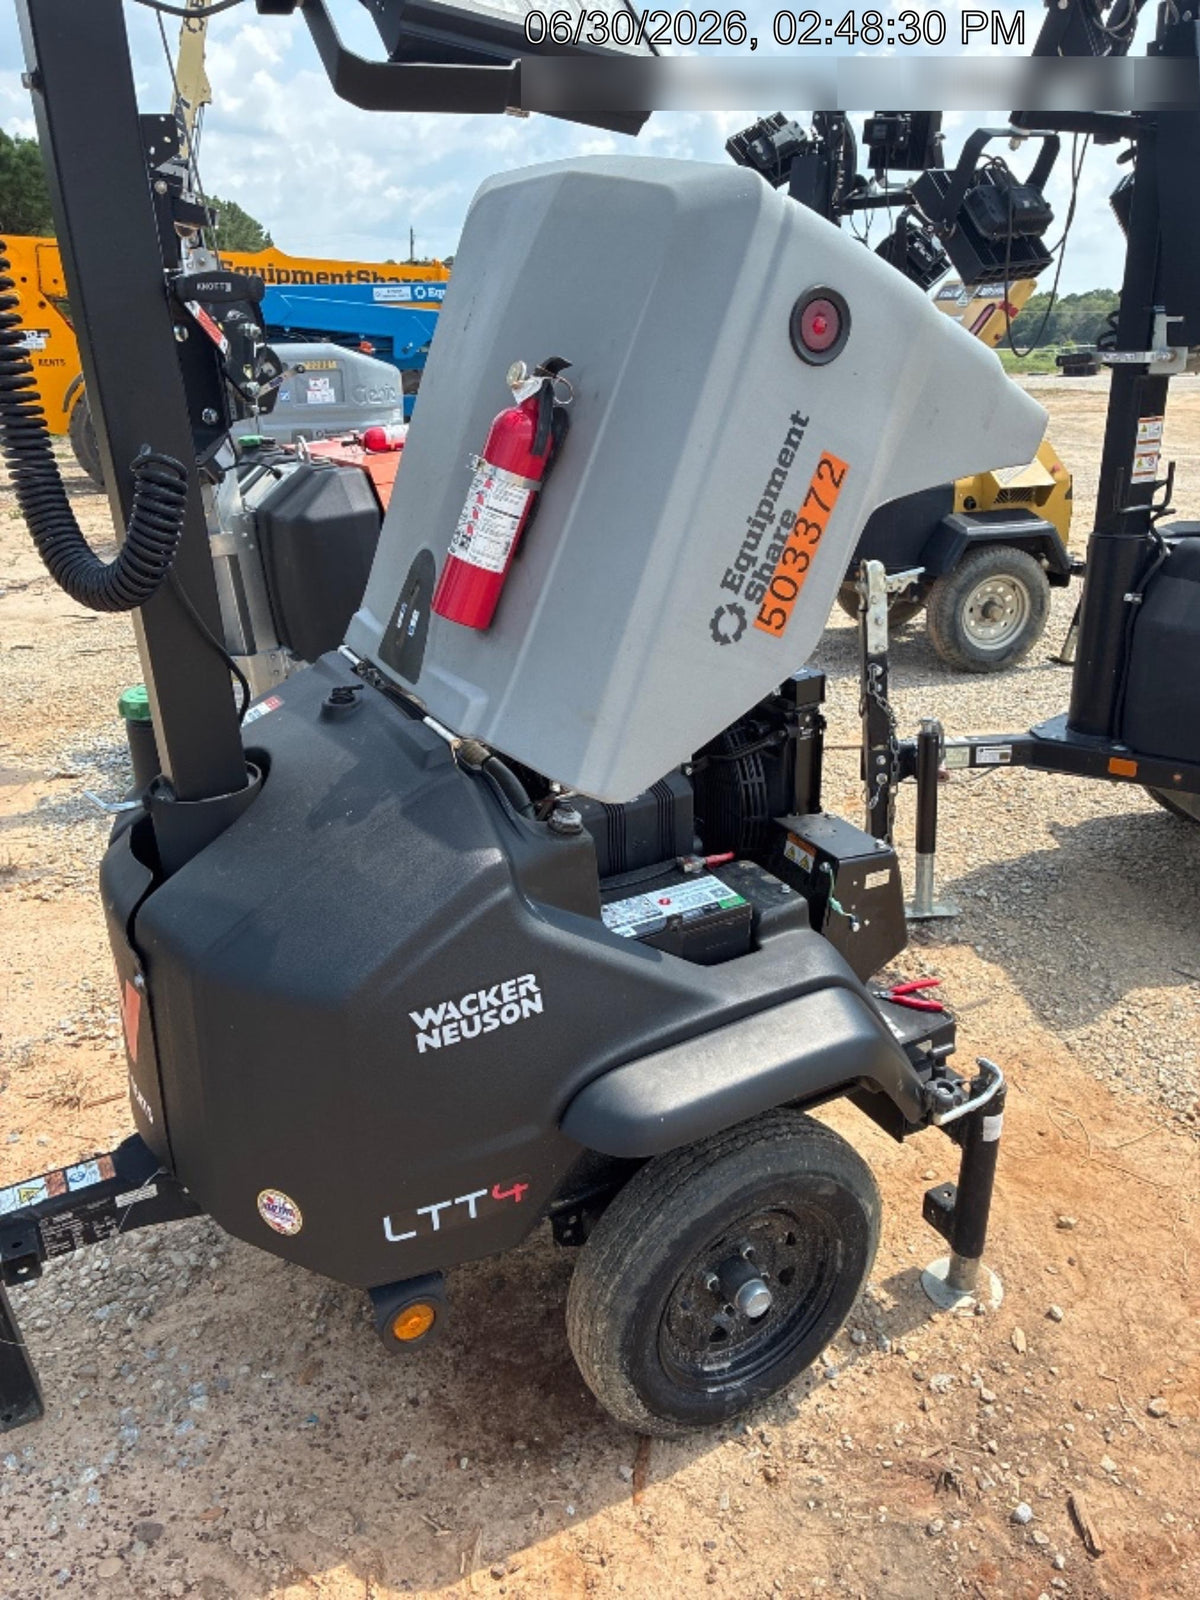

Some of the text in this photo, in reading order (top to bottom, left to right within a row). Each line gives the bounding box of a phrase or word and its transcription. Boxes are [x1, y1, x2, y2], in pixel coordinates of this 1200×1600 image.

[428, 287, 446, 300] Eq
[720, 410, 810, 595] Equipment
[744, 508, 797, 605] Share
[756, 457, 846, 631] 503372
[408, 973, 541, 1031] WACKER
[415, 992, 544, 1054] NEUSON
[383, 1183, 529, 1242] LTT4
